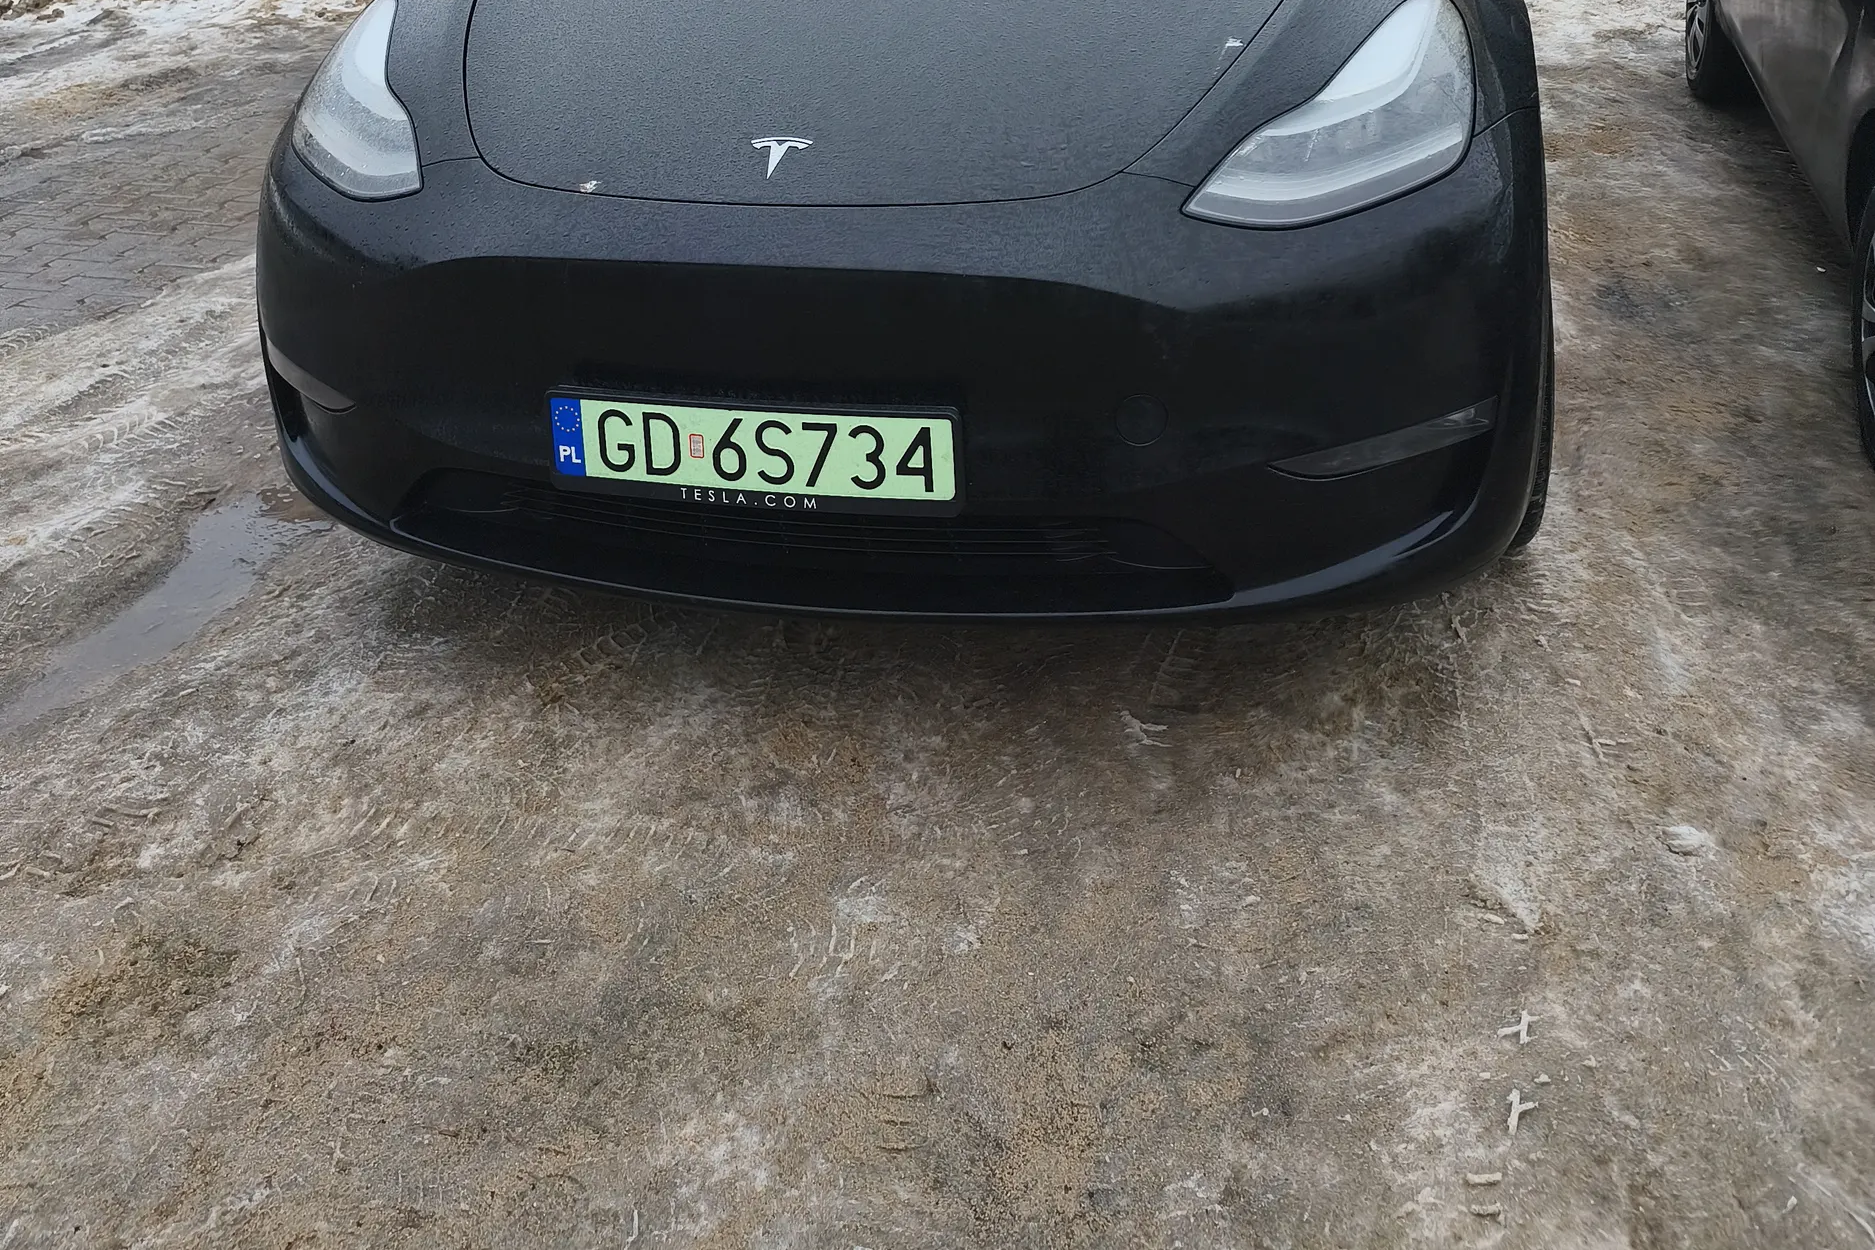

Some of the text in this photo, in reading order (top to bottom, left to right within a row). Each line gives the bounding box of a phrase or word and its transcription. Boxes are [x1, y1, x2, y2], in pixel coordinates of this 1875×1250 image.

[558, 444, 582, 464] PL
[597, 408, 936, 494] GD 6S734
[680, 487, 818, 510] TESLA.COM
